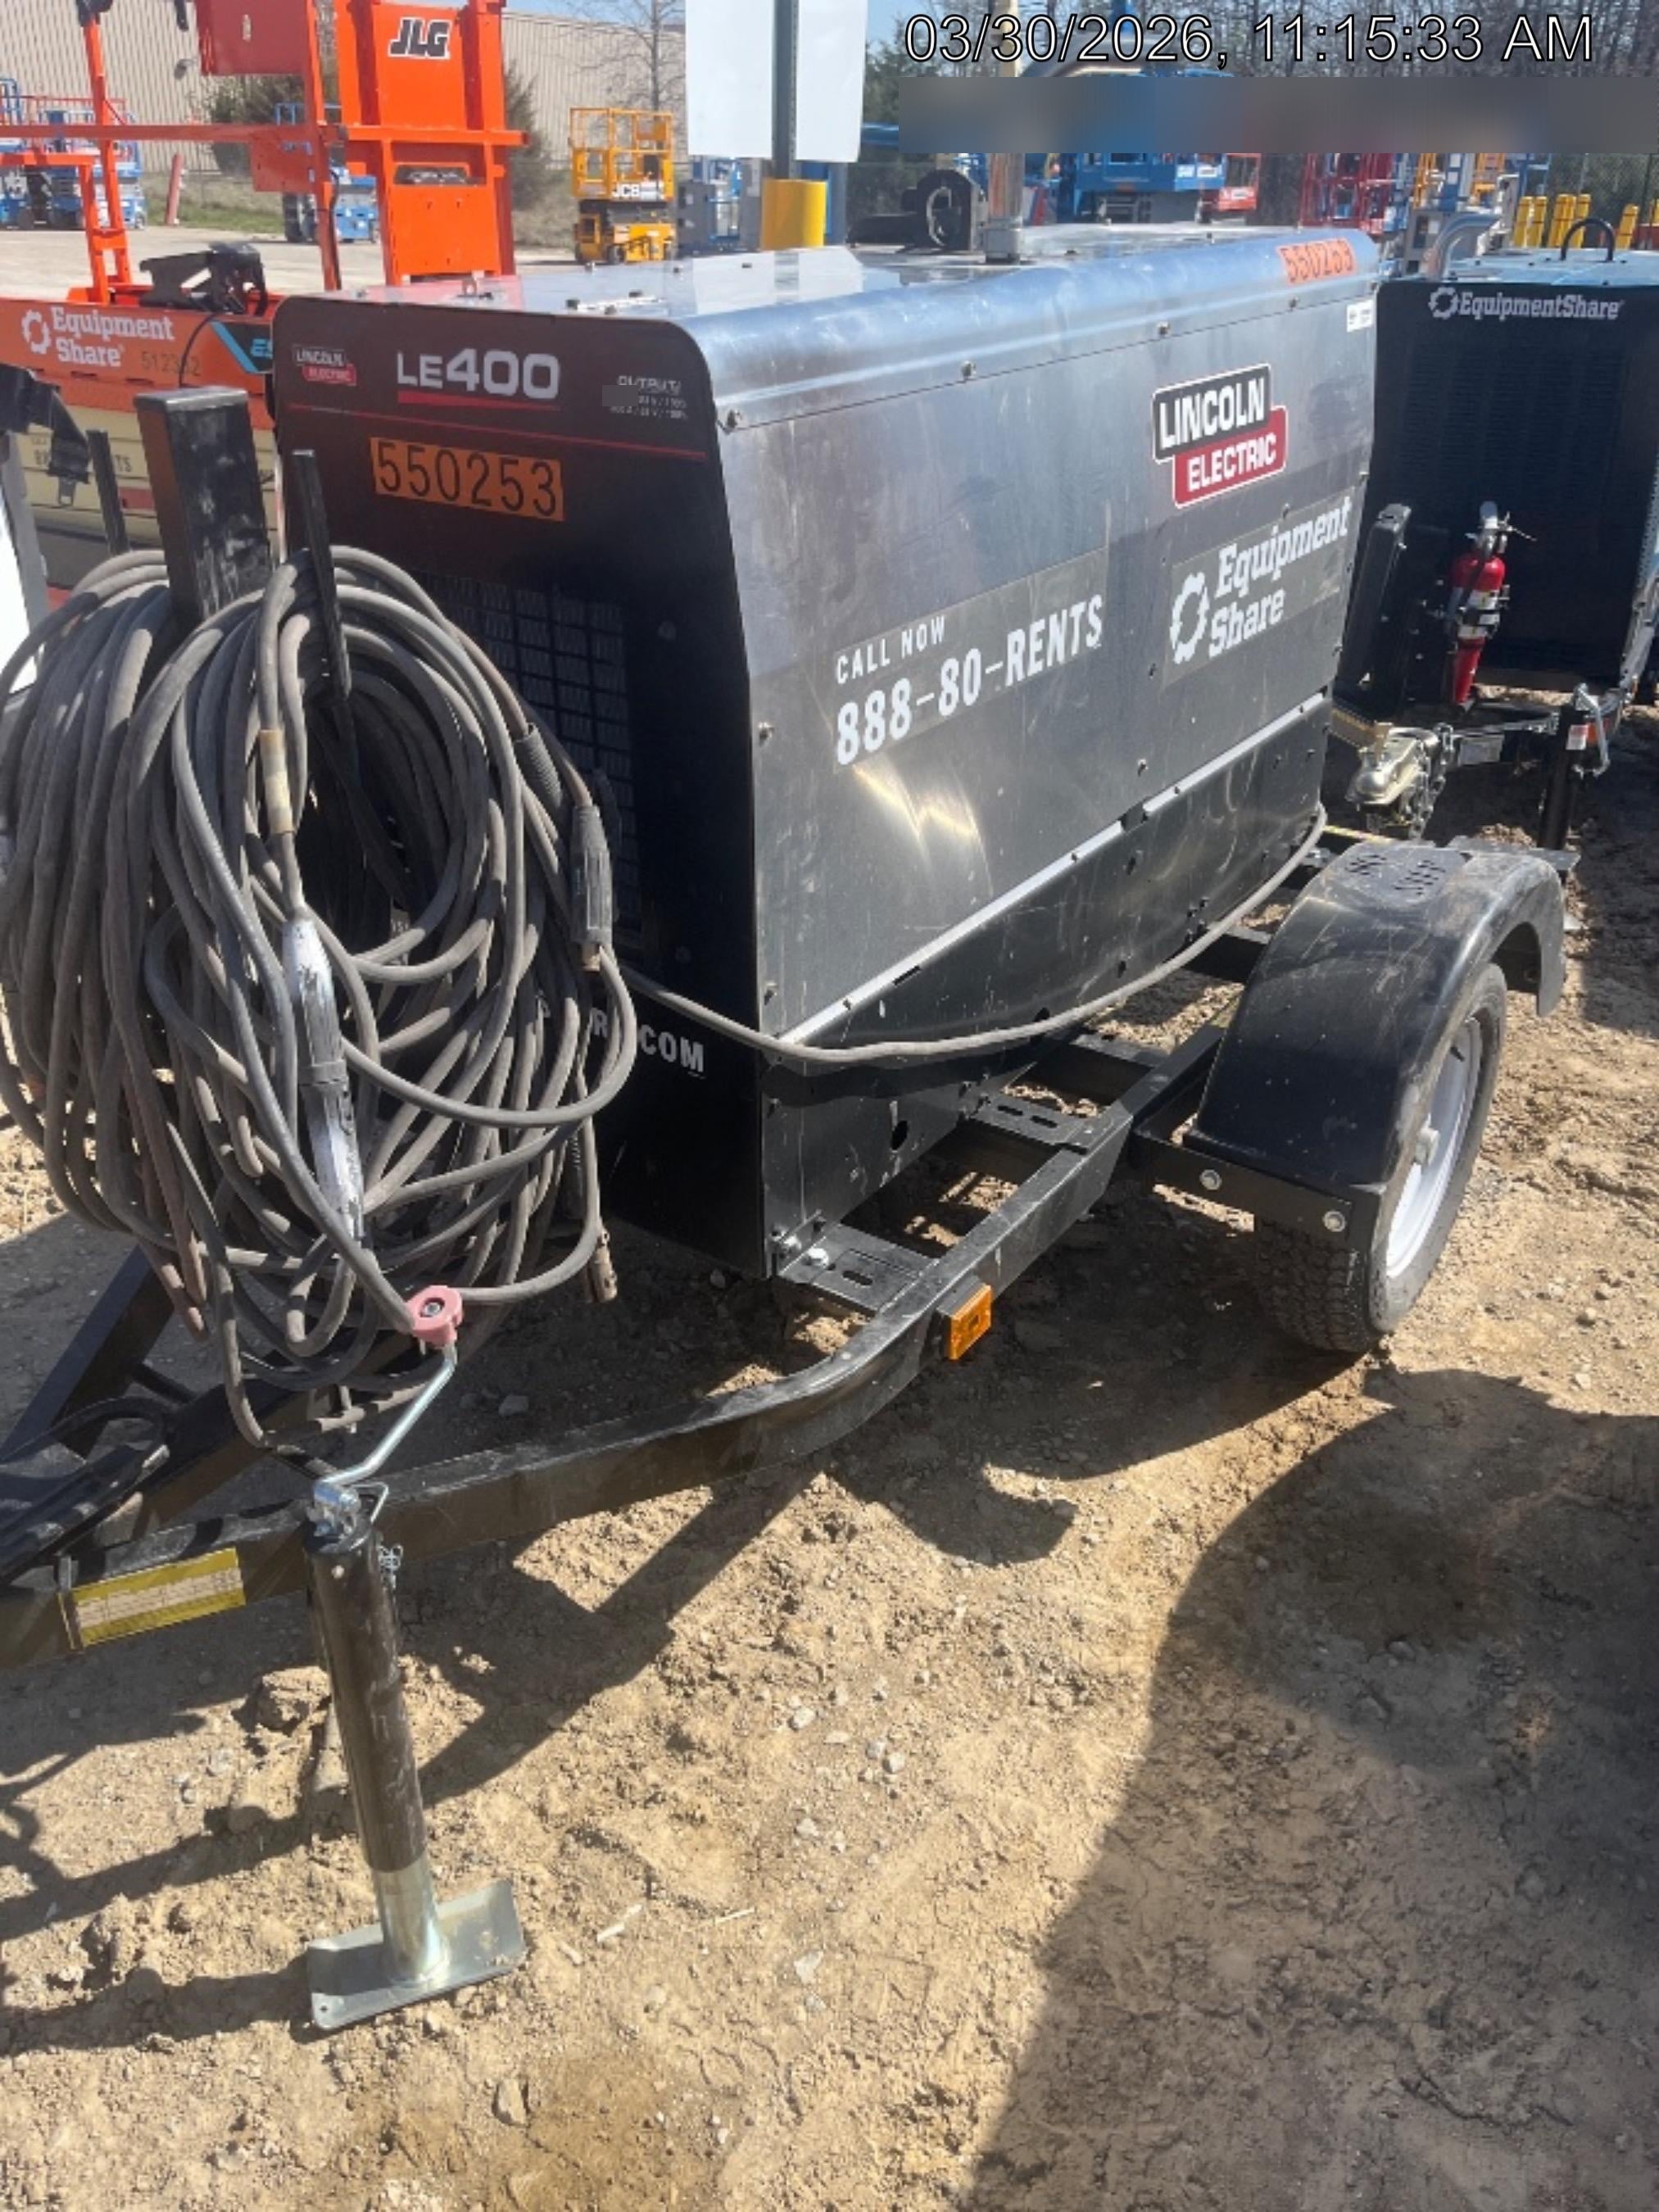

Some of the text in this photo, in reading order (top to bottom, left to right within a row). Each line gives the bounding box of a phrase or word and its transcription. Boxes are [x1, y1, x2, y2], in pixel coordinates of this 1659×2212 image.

[388, 16, 451, 60] JLG
[50, 306, 175, 341] Equipment
[1458, 292, 1620, 322] EquipmentShare
[55, 337, 122, 367] Share
[397, 347, 561, 399] LE400
[1158, 377, 1266, 451] LINCOLN
[377, 441, 556, 517] 550253
[1187, 432, 1277, 492] ELECTRIC
[1214, 495, 1351, 599] Equipment
[836, 614, 945, 685] CALL NOW
[1208, 587, 1285, 659] Share
[836, 594, 1103, 765] 888-80-RENTS
